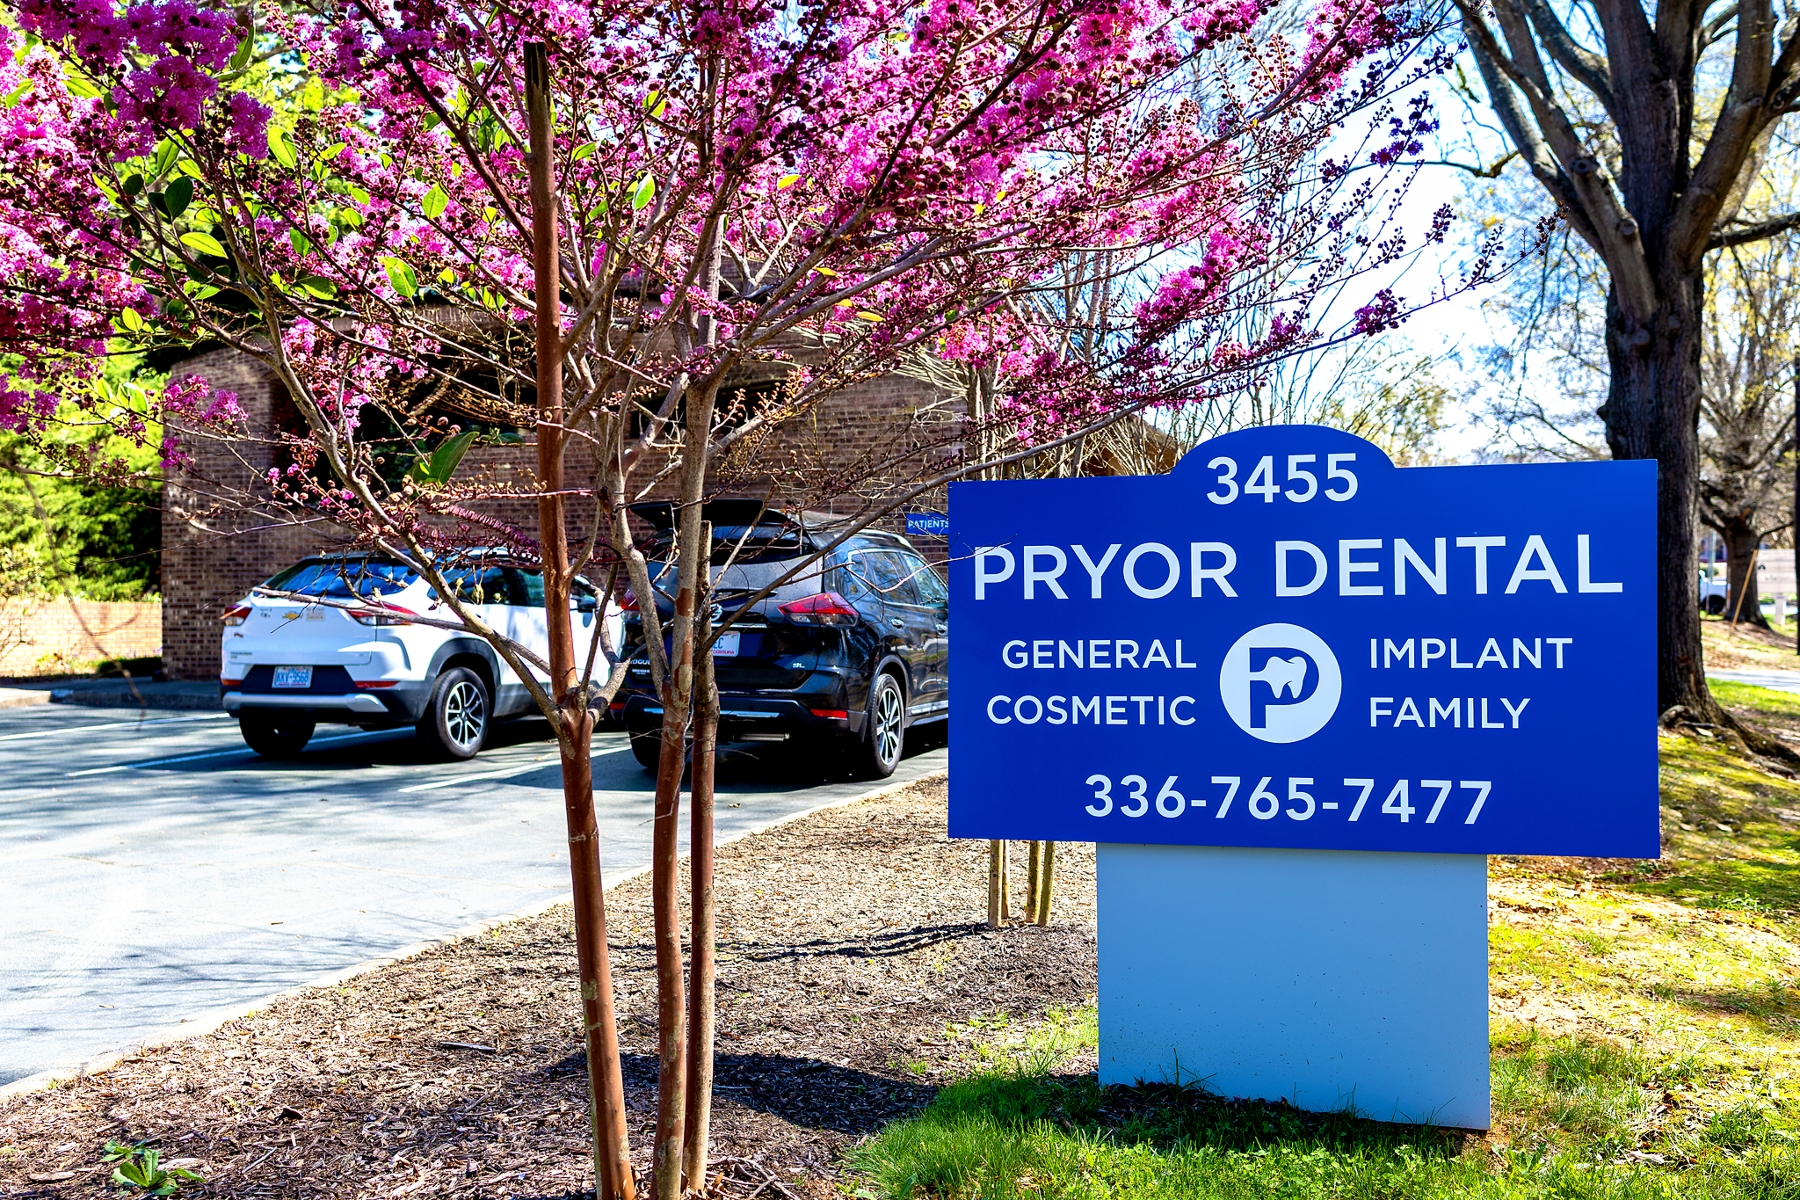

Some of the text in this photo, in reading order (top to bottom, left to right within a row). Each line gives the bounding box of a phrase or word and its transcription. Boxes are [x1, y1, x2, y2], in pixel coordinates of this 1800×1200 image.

[1206, 452, 1359, 505] 3455
[974, 534, 1623, 601] PRYOR DENTAL
[1002, 639, 1197, 669] GENERAL
[1370, 637, 1573, 669] IMPLANT
[986, 694, 1196, 726] COSMETIC
[1370, 696, 1531, 729] FAMILY
[1084, 774, 1492, 825] 336-765-7477
